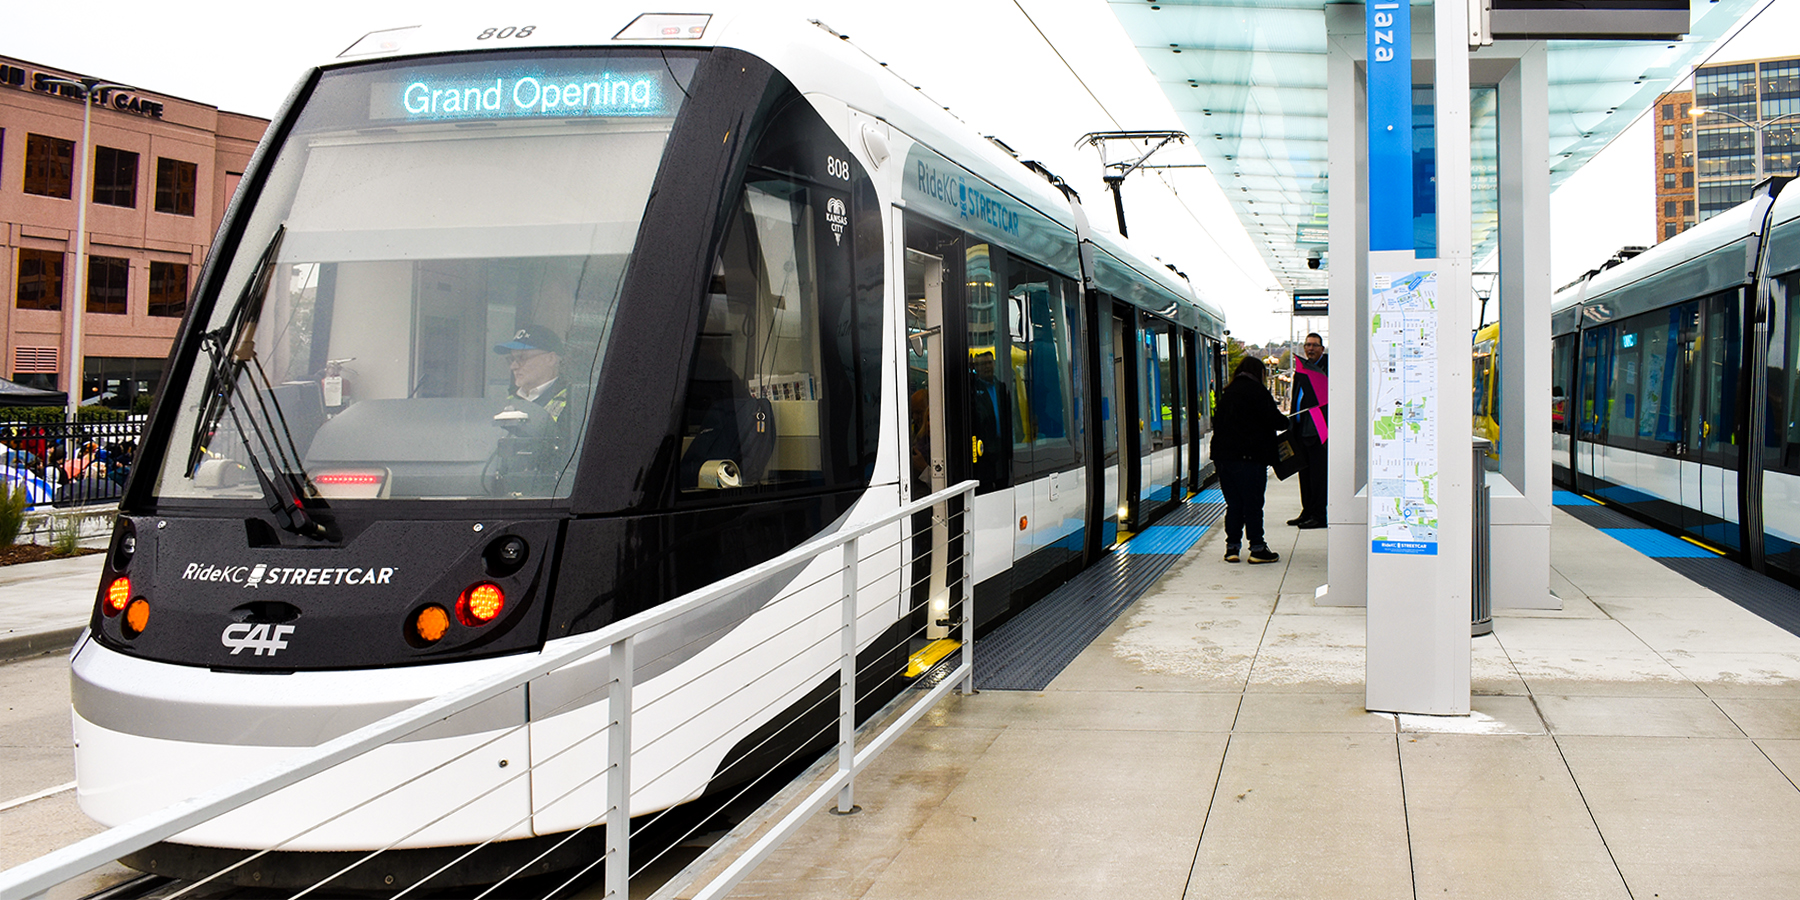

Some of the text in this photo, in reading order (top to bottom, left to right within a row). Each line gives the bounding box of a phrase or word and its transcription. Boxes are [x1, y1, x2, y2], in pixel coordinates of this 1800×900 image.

[476, 25, 537, 41] 808
[1373, 0, 1399, 62] laza
[113, 91, 164, 119] CAFE
[403, 72, 651, 114] Grand Opening
[826, 155, 850, 181] 808
[917, 159, 1020, 238] RideKC STREETCAR
[825, 212, 849, 226] KANSAS
[830, 223, 845, 235] CITY
[182, 562, 394, 586] RideKC STREETCAR
[221, 623, 295, 656] CAF
